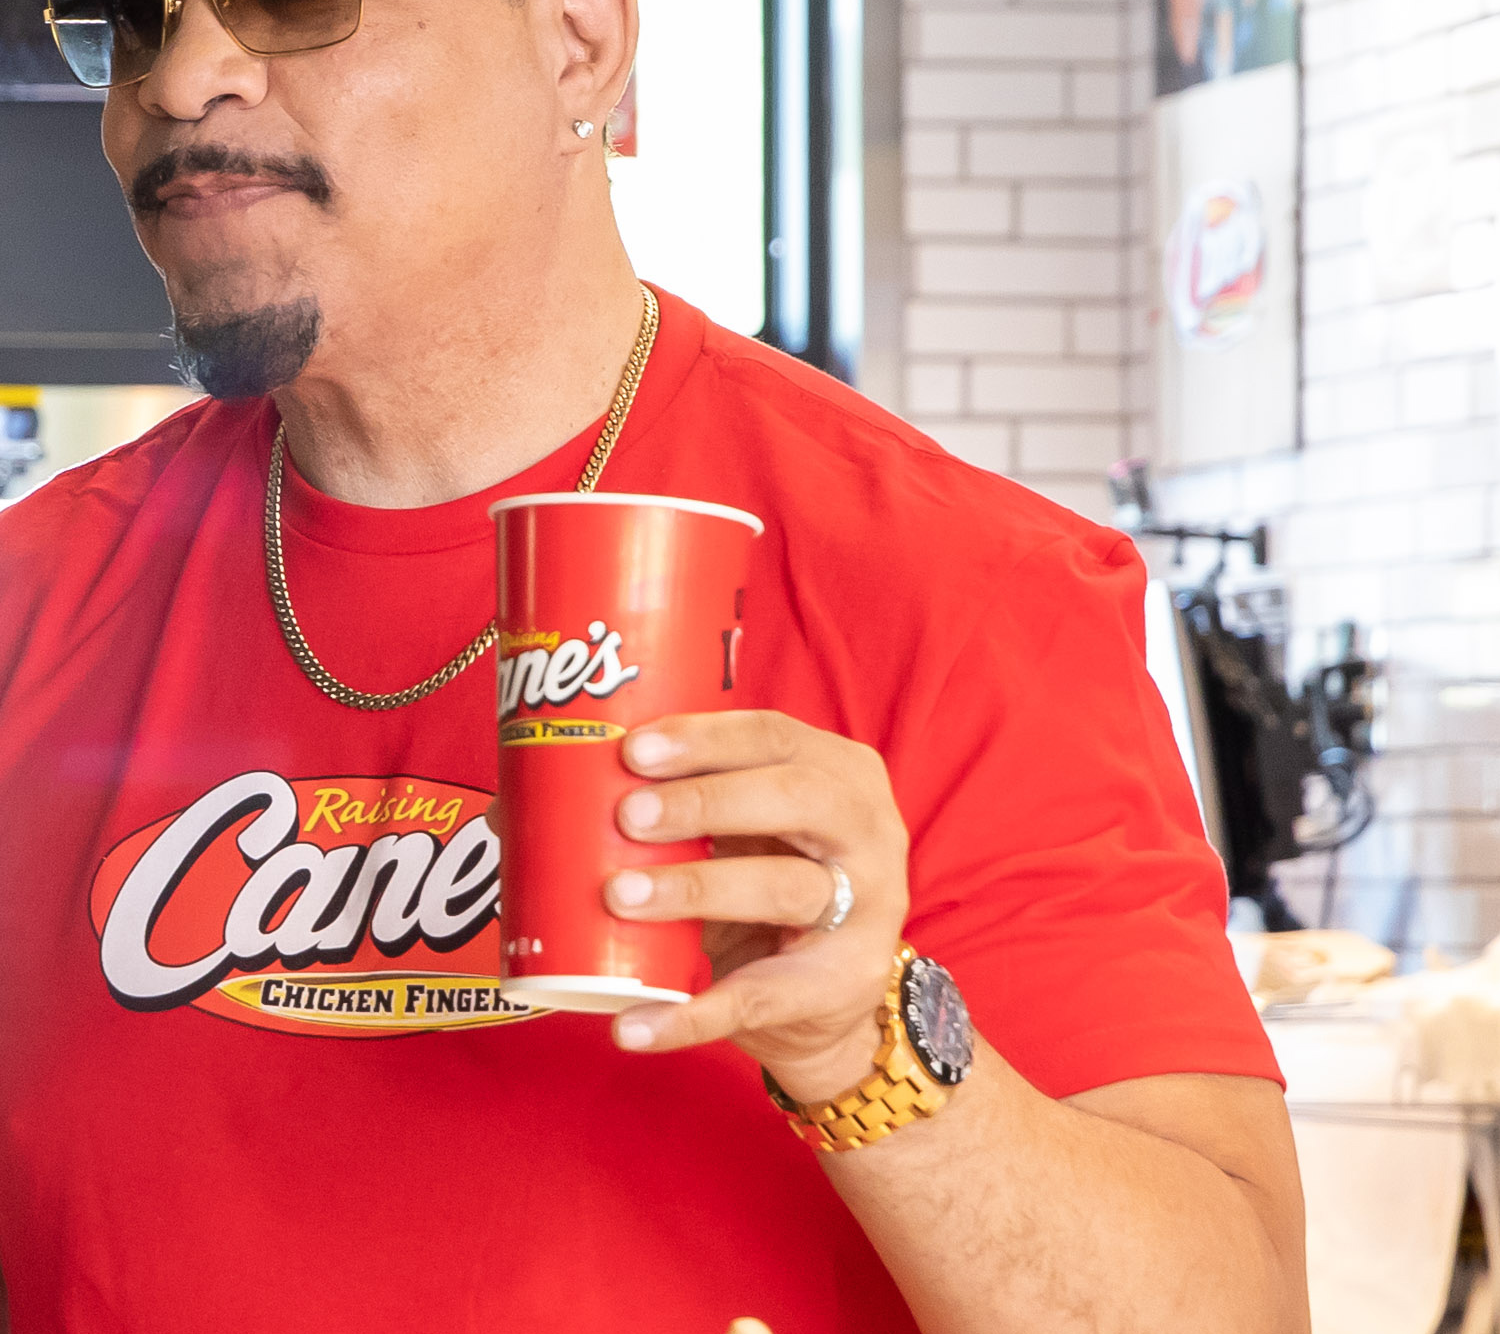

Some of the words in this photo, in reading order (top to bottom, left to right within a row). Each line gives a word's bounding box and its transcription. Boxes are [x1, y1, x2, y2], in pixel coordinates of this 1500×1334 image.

[500, 620, 641, 718] ane's
[303, 784, 464, 836] Raising
[101, 770, 500, 1005] Cane
[260, 978, 394, 1014] CHICKEN
